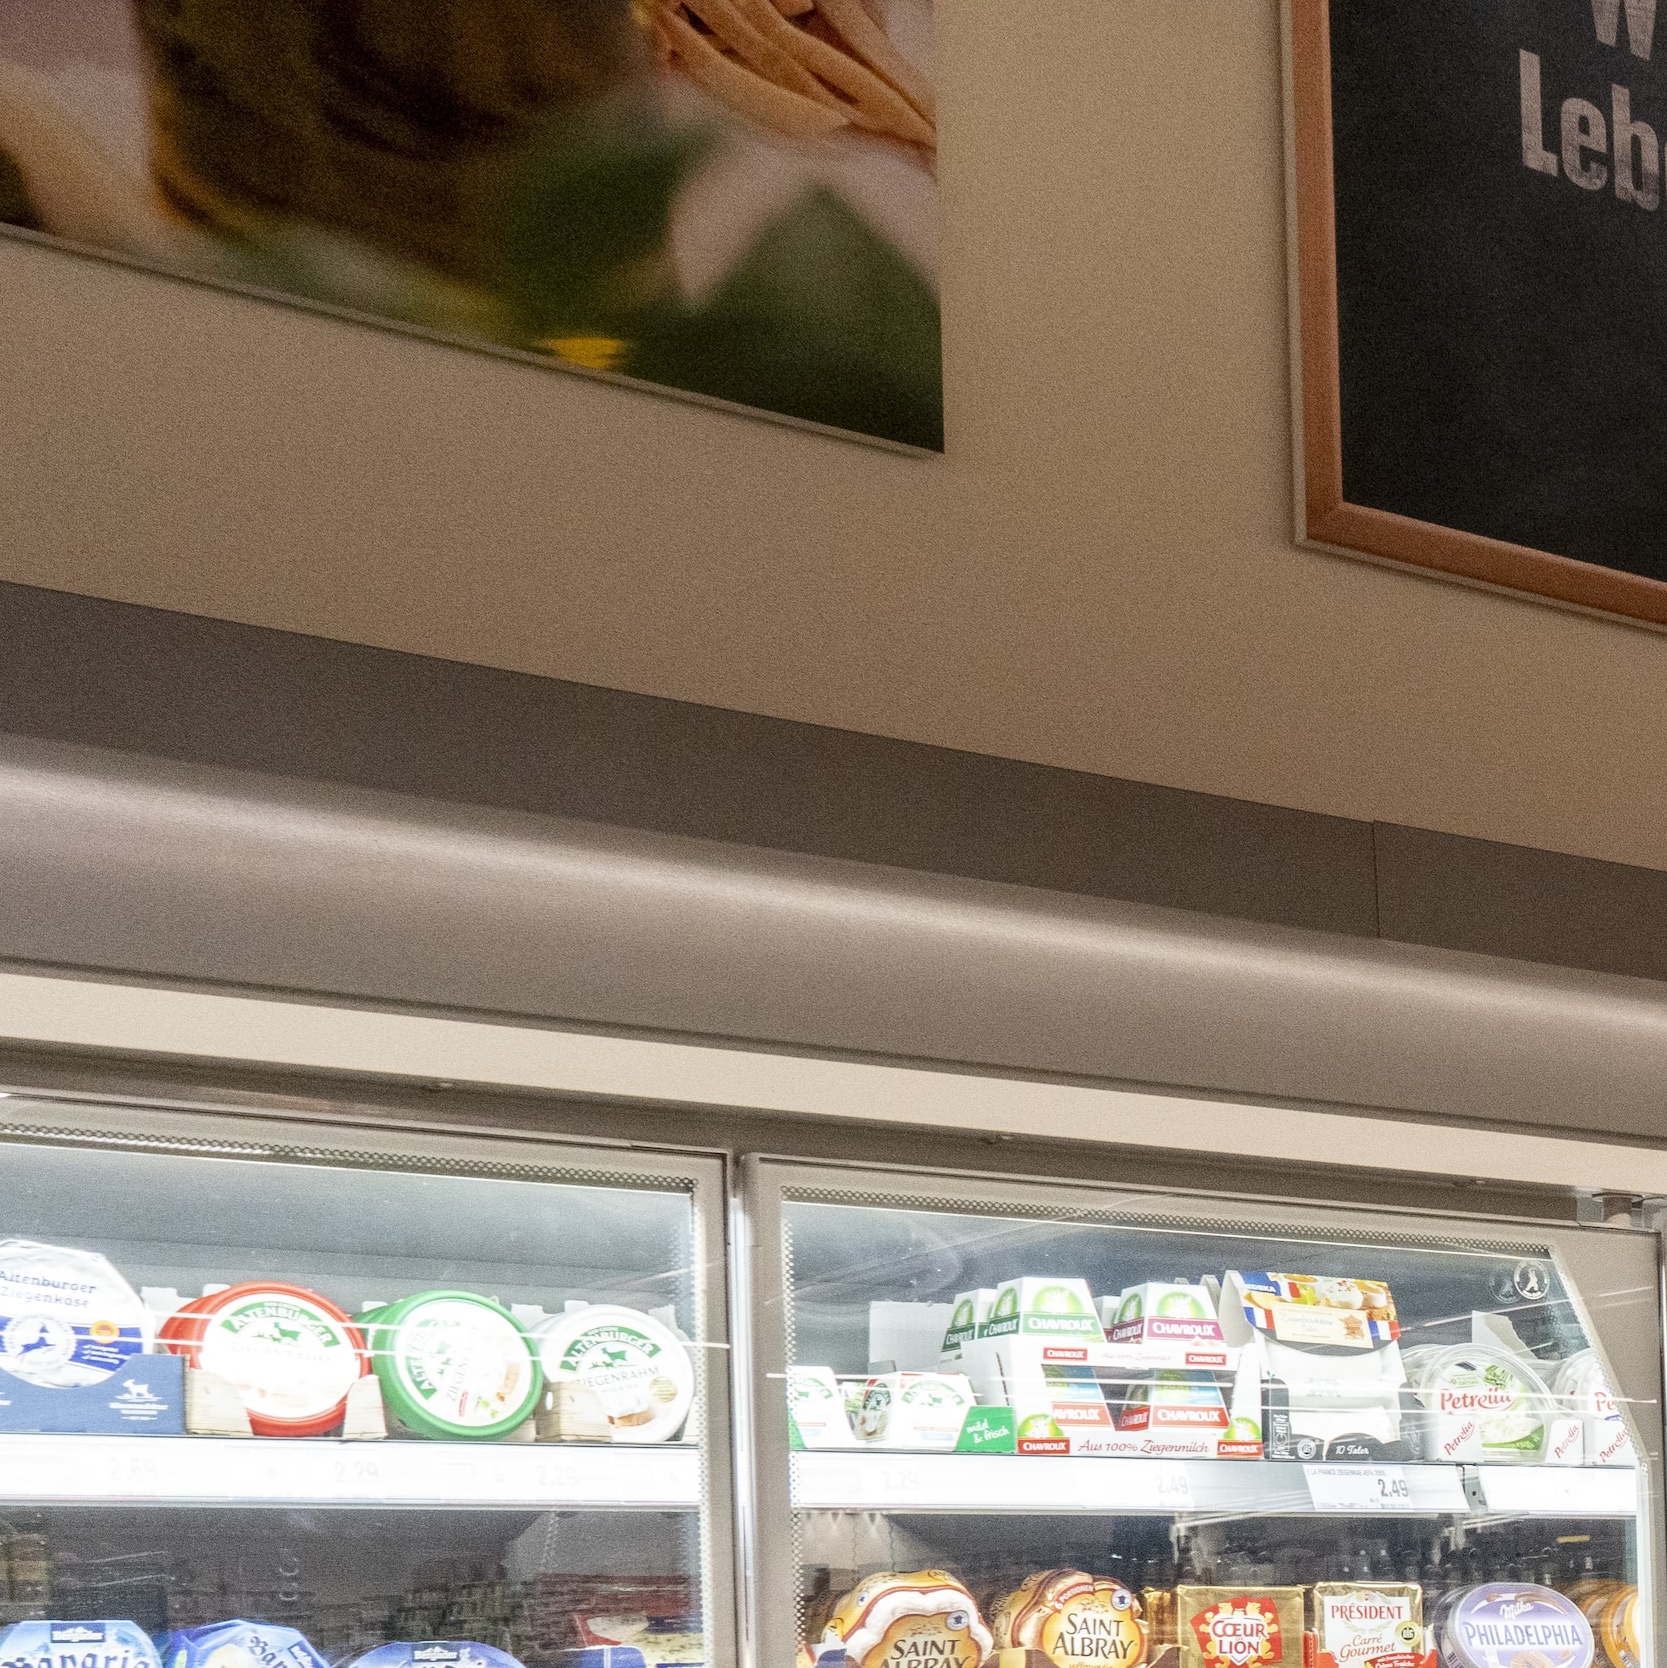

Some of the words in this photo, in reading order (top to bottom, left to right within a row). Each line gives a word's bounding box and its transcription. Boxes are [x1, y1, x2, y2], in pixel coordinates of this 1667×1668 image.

[1028, 1316, 1096, 1332] CHAVROUX
[1152, 1321, 1216, 1337] CHAVROUX
[568, 1332, 655, 1368] ALTENBURGER
[1440, 1388, 1515, 1411] Petrella
[1157, 1409, 1222, 1422] CHAVROUX
[1330, 1603, 1404, 1621] PRÉSIDENT
[1066, 1612, 1124, 1636] SAINT
[1464, 1620, 1584, 1648] PHILADELPHIA
[890, 1638, 960, 1660] SAINT
[1052, 1630, 1137, 1660] ALBRAY
[1218, 1640, 1261, 1656] LION
